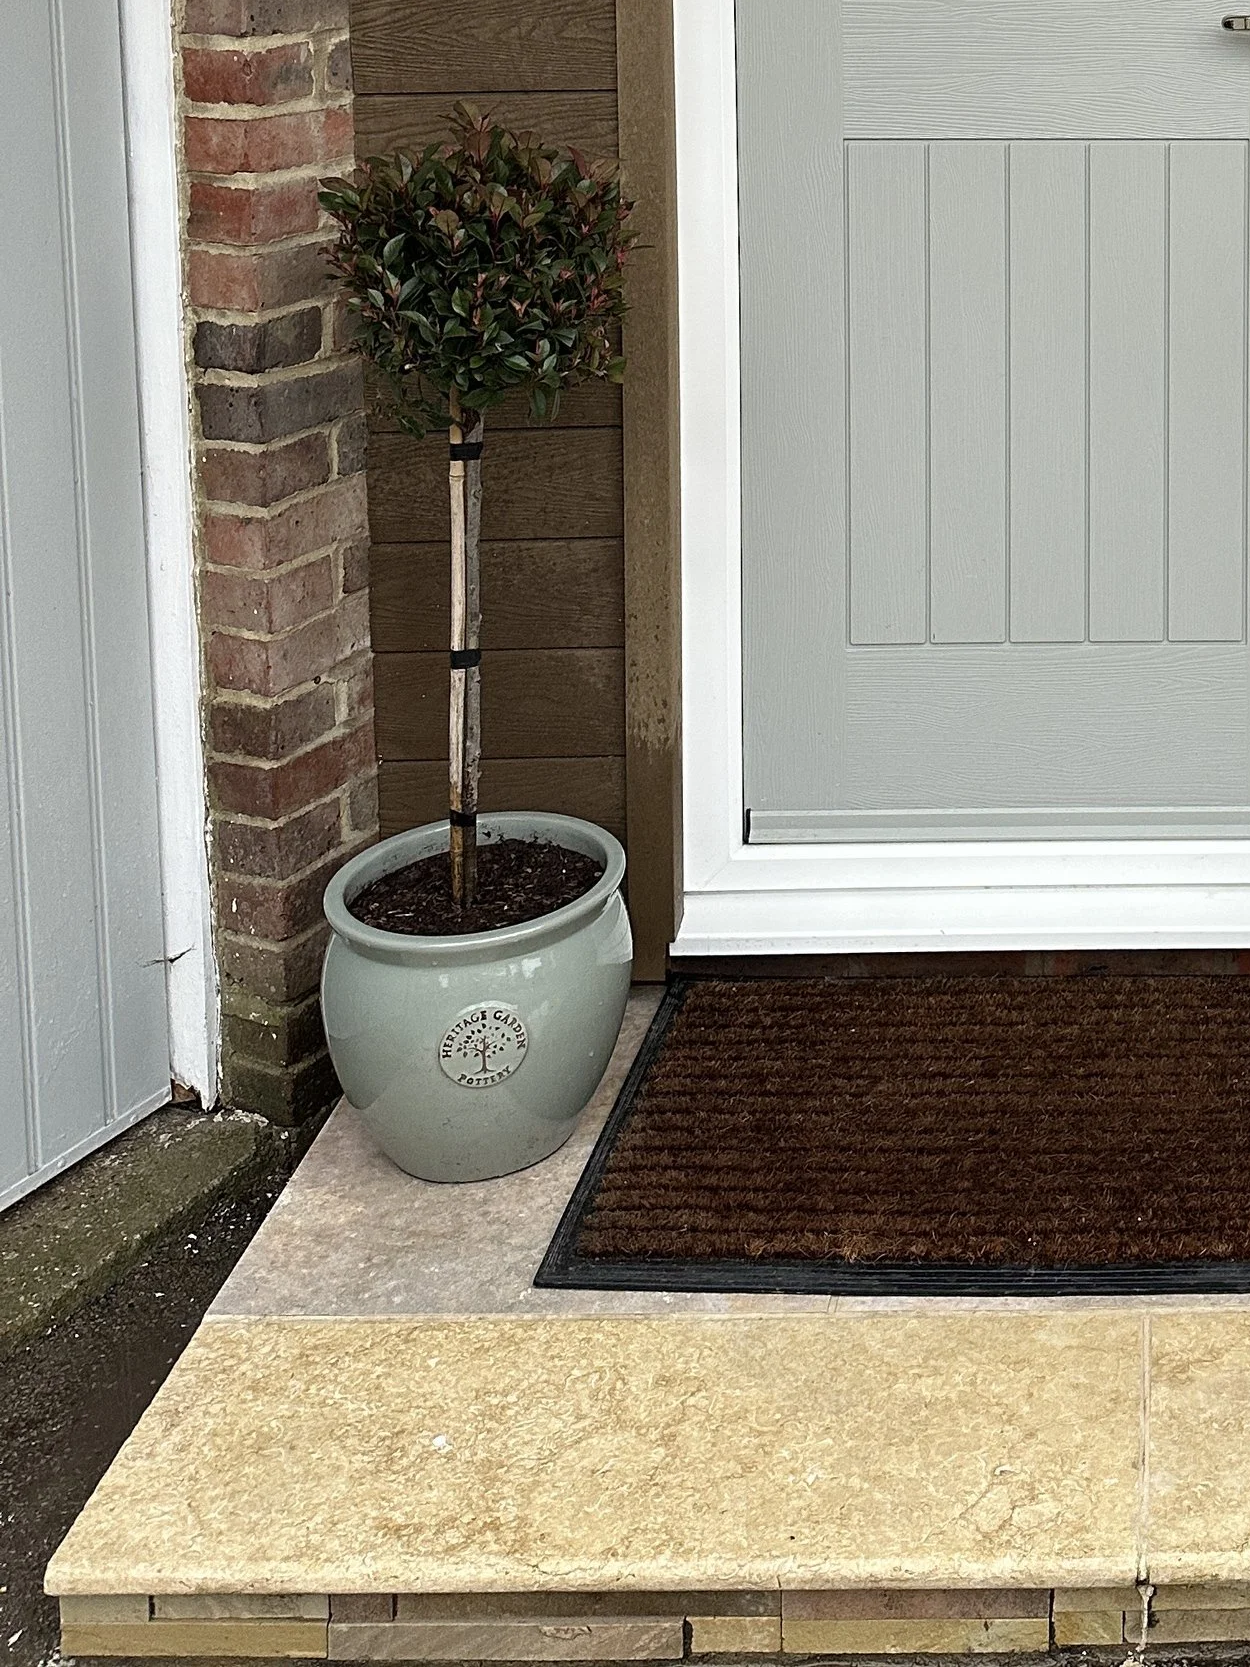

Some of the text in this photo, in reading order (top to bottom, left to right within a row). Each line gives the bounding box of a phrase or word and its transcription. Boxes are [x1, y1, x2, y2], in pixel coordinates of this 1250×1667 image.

[442, 1010, 527, 1059] HERITAGE GARDEN
[457, 1065, 512, 1086] POTTERY
